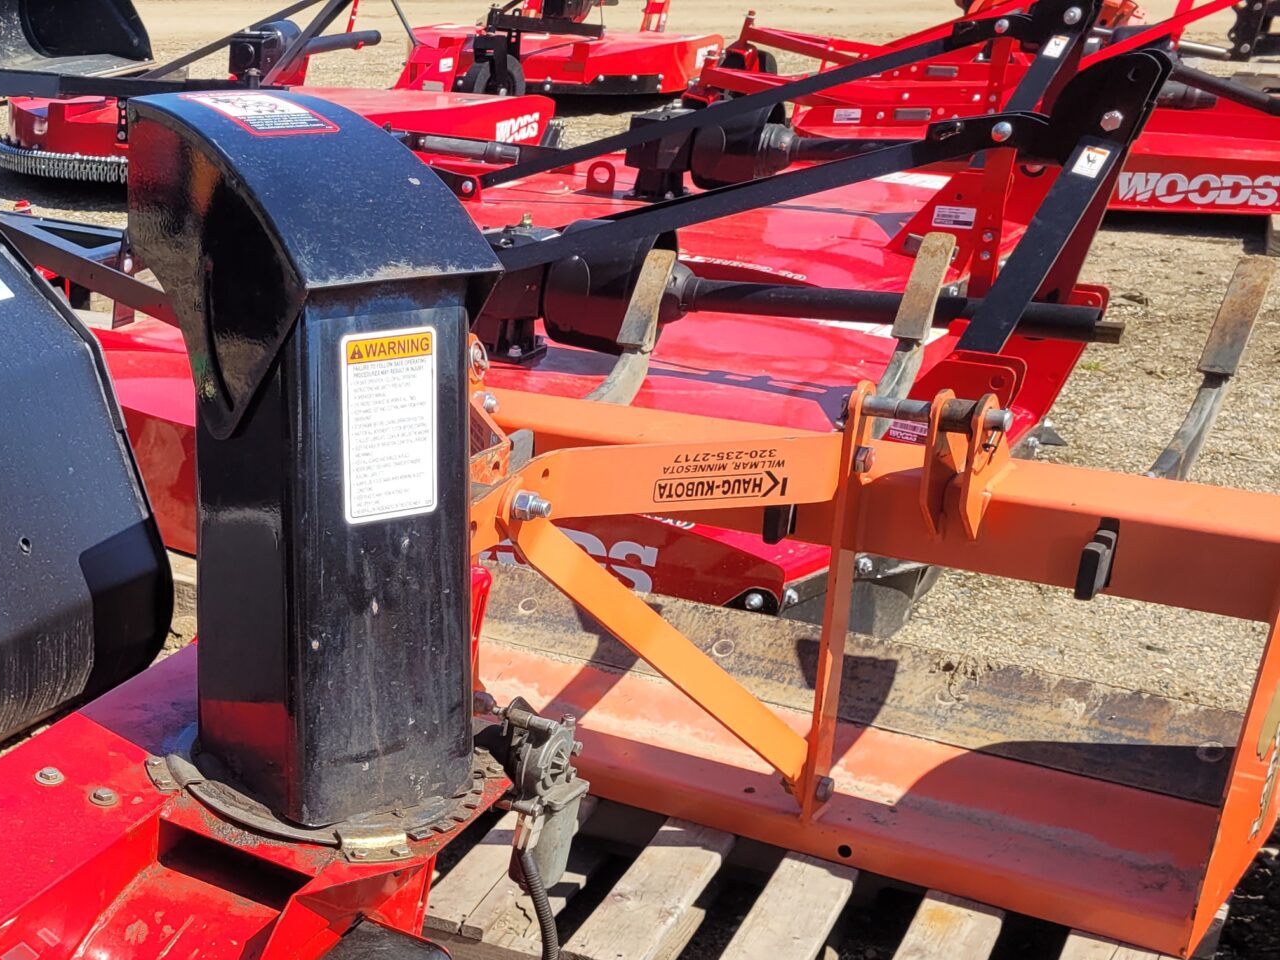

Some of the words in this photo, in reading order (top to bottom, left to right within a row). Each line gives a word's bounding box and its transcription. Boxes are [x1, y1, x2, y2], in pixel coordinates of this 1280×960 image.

[496, 112, 540, 143] WOODS
[1119, 172, 1280, 206] WOODS
[365, 337, 430, 358] WARNING
[674, 449, 777, 464] 320-235-2717
[731, 459, 785, 470] WILLMAR,
[662, 462, 728, 474] MINNESOTA
[658, 476, 764, 499] HAUG-KUBOTA
